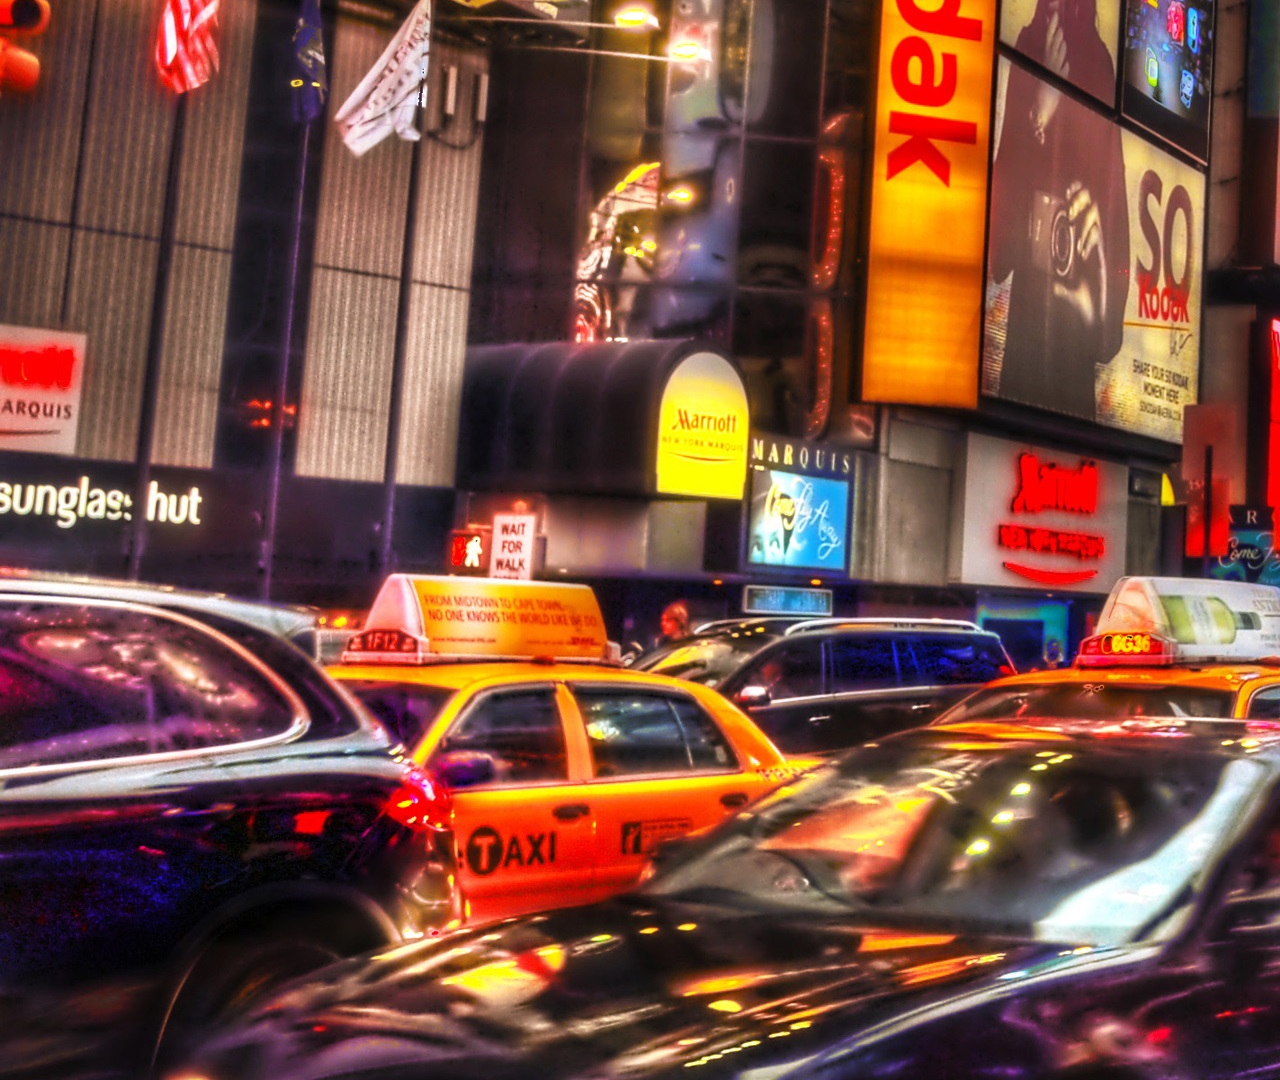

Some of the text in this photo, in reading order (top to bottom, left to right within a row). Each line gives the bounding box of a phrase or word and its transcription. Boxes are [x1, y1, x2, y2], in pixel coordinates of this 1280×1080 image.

[1136, 169, 1195, 298] SO
[672, 408, 738, 434] Marriott
[683, 438, 705, 448] YORK
[707, 441, 745, 453] MARQUIS
[752, 438, 851, 475] MARQUIS
[146, 480, 202, 526] hut
[501, 522, 526, 536] WAIT
[501, 540, 523, 553] FOR
[495, 558, 526, 572] WALK
[424, 594, 452, 606] FROM
[453, 595, 499, 608] MIDTOWN
[499, 597, 512, 609] TO
[512, 598, 535, 610] CAPE
[428, 608, 444, 621] NO
[444, 609, 465, 622] ONE
[466, 610, 499, 623] KNOWS
[499, 611, 518, 624] THE
[519, 613, 551, 626] WORLD
[366, 632, 398, 651] 1F12
[467, 826, 557, 876] TAXI
